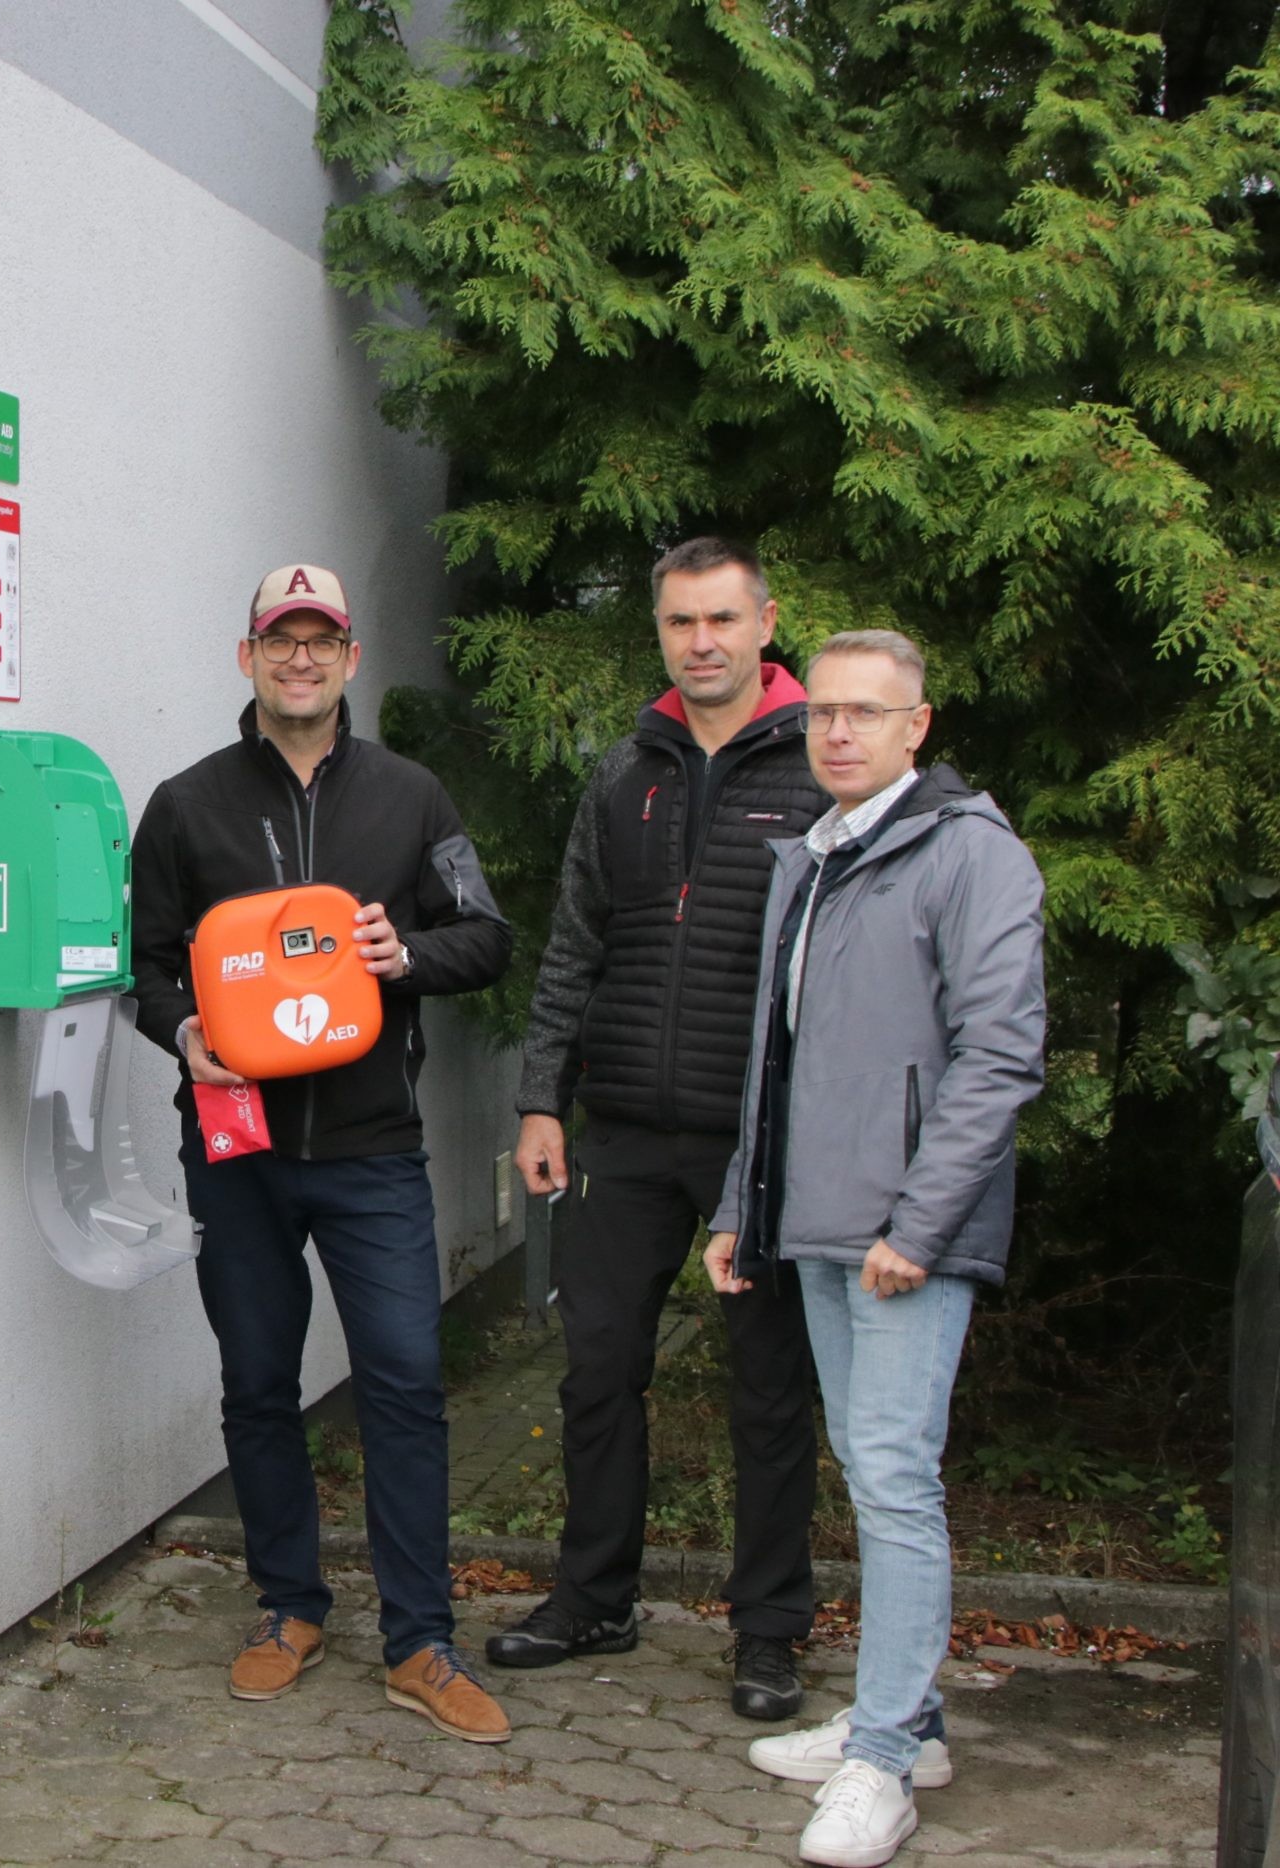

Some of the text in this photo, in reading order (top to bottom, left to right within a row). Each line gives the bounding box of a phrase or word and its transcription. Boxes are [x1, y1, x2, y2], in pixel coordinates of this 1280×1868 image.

[1, 423, 14, 440] AED
[285, 568, 316, 595] A
[872, 883, 896, 896] 4F
[222, 951, 265, 974] IPAD
[326, 1024, 359, 1043] AED
[237, 1105, 246, 1119] AED
[244, 1103, 256, 1132] PROJEKT
